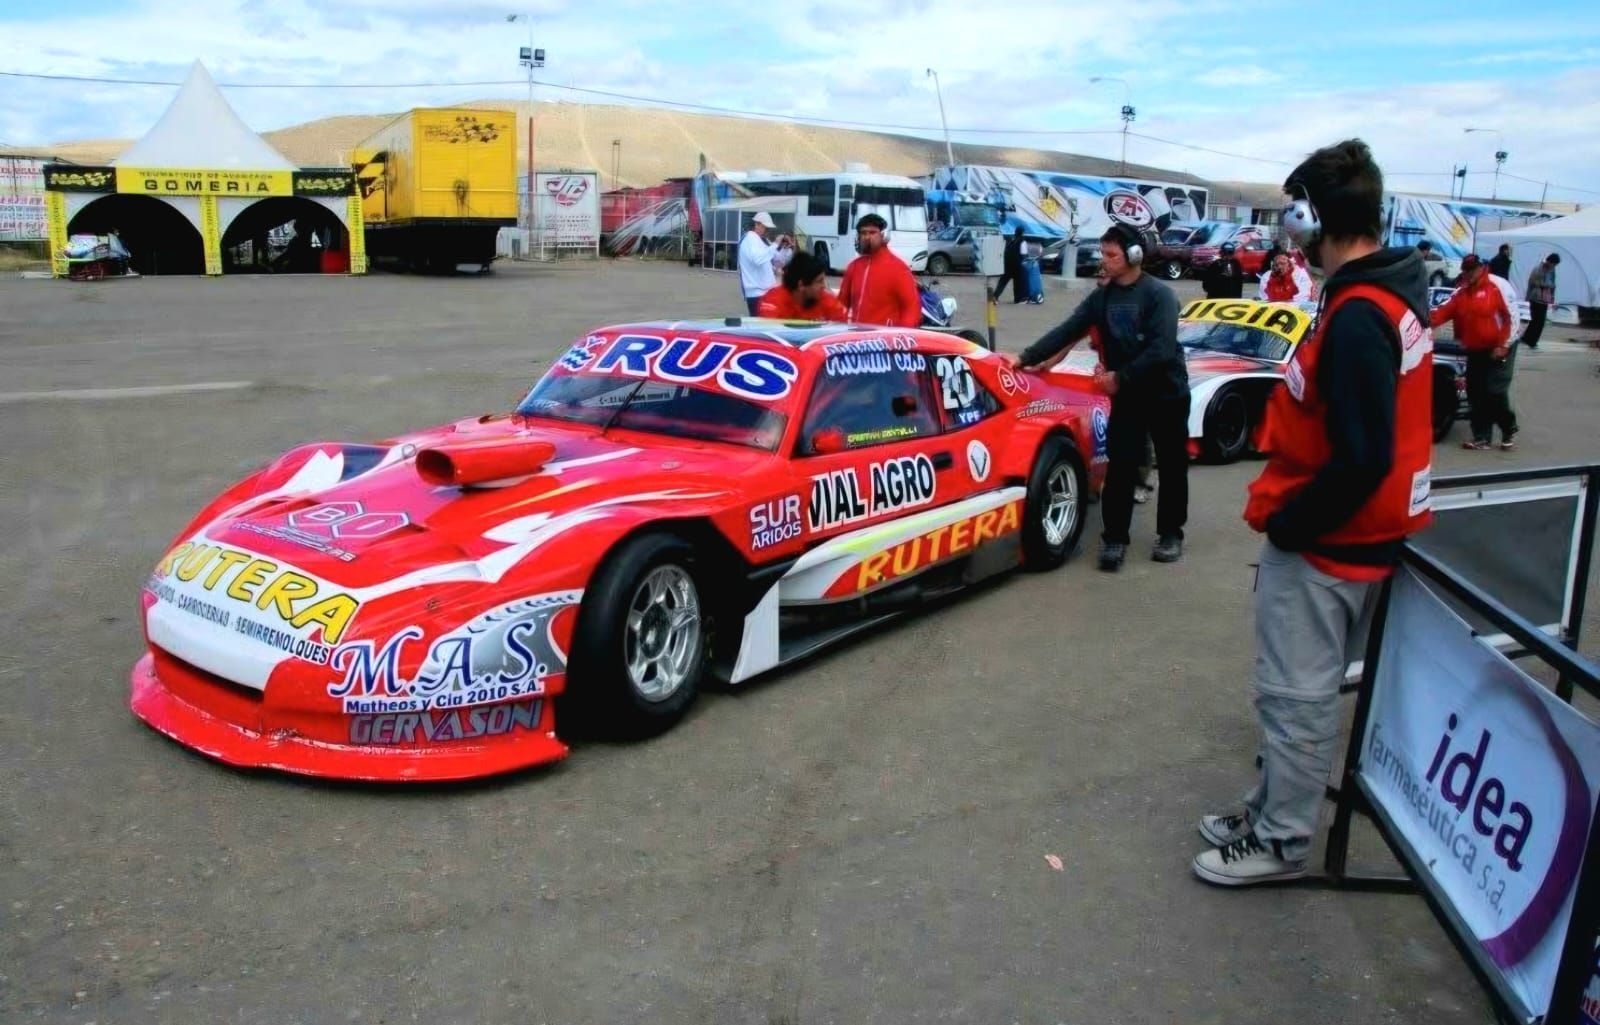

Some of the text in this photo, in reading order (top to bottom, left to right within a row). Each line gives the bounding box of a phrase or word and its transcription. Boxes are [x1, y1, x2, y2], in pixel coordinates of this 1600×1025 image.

[144, 178, 270, 193] GOMERIA
[596, 336, 797, 398] RUS
[750, 494, 800, 534] SUR
[809, 456, 934, 527] VIAL AGRO
[752, 521, 802, 550] ARIDOS
[856, 502, 1019, 593] RUTERA
[154, 541, 360, 645] RUTERA
[235, 615, 330, 664] SEMIRREMOLQUES
[330, 622, 546, 696] M.A.S.
[346, 680, 542, 713] Matheos y Cia 2010 S.A.
[1425, 712, 1533, 873] idea
